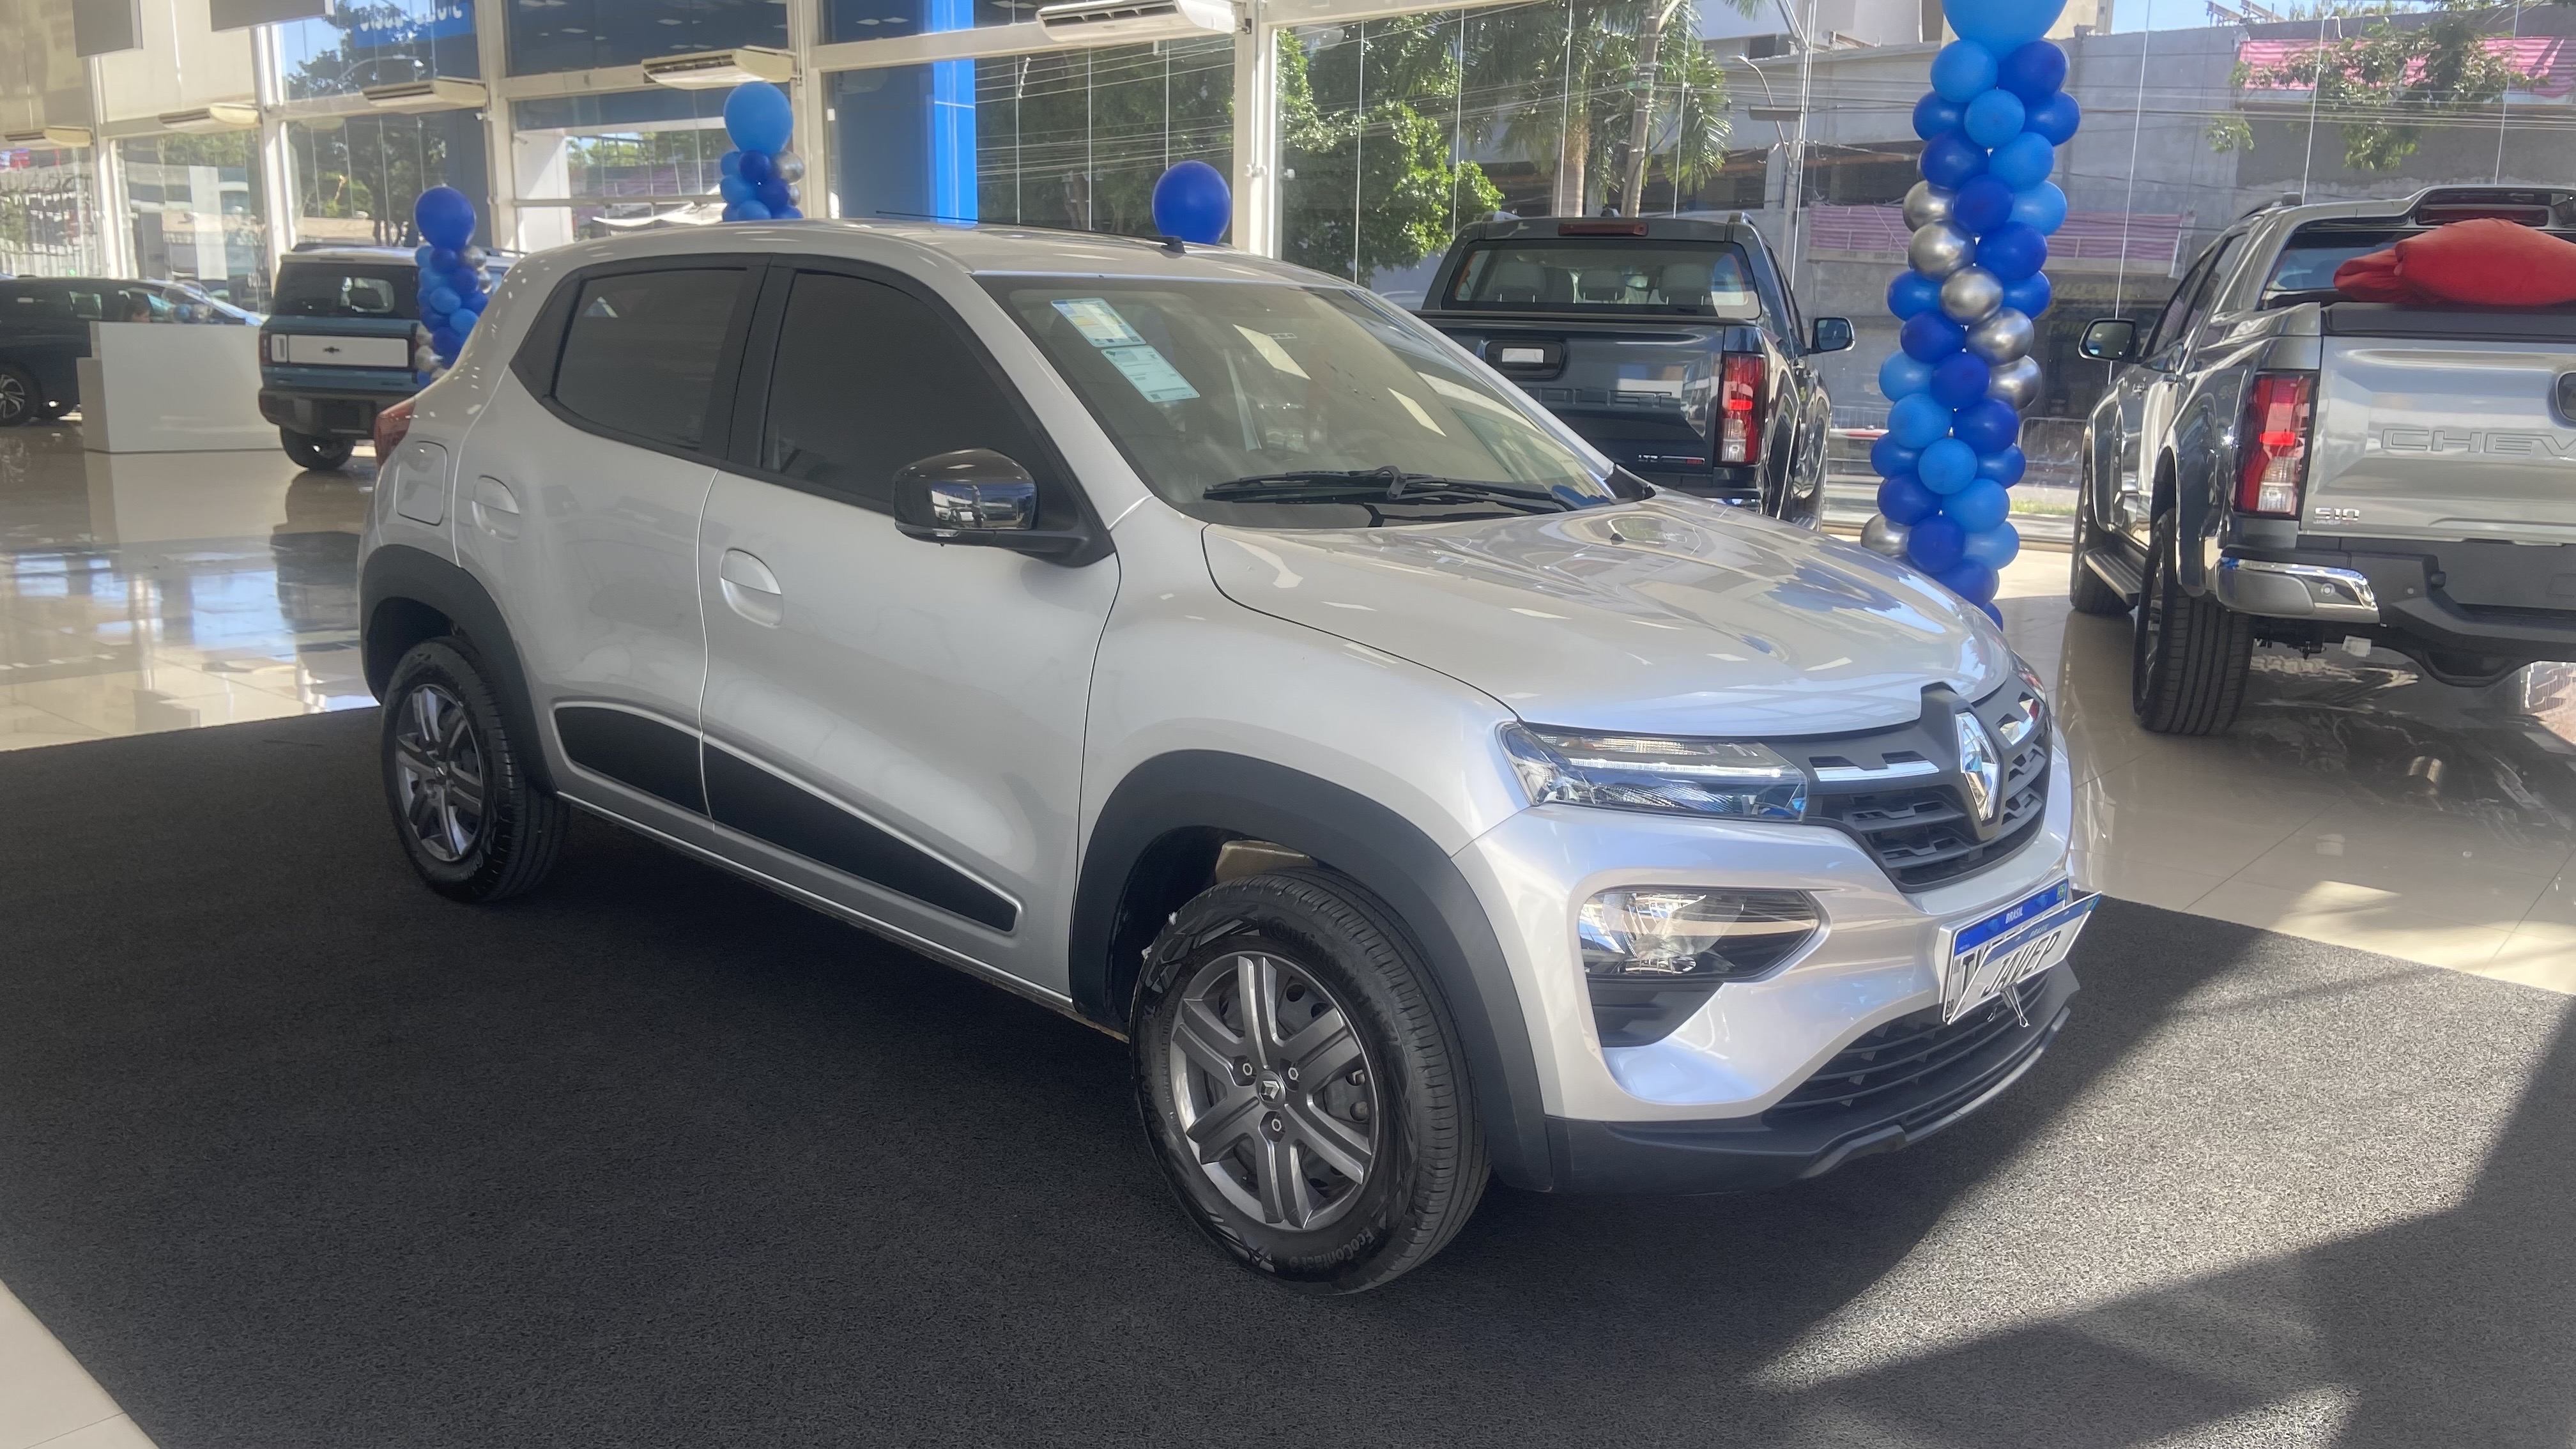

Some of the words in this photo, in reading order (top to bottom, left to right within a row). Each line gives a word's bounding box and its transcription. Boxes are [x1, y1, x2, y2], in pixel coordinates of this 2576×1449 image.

[2314, 507, 2360, 521] S10
[2005, 906, 2024, 924] BRASIL
[1980, 930, 2062, 999] JAVEP
[1300, 1224, 1376, 1273] EcoContact
